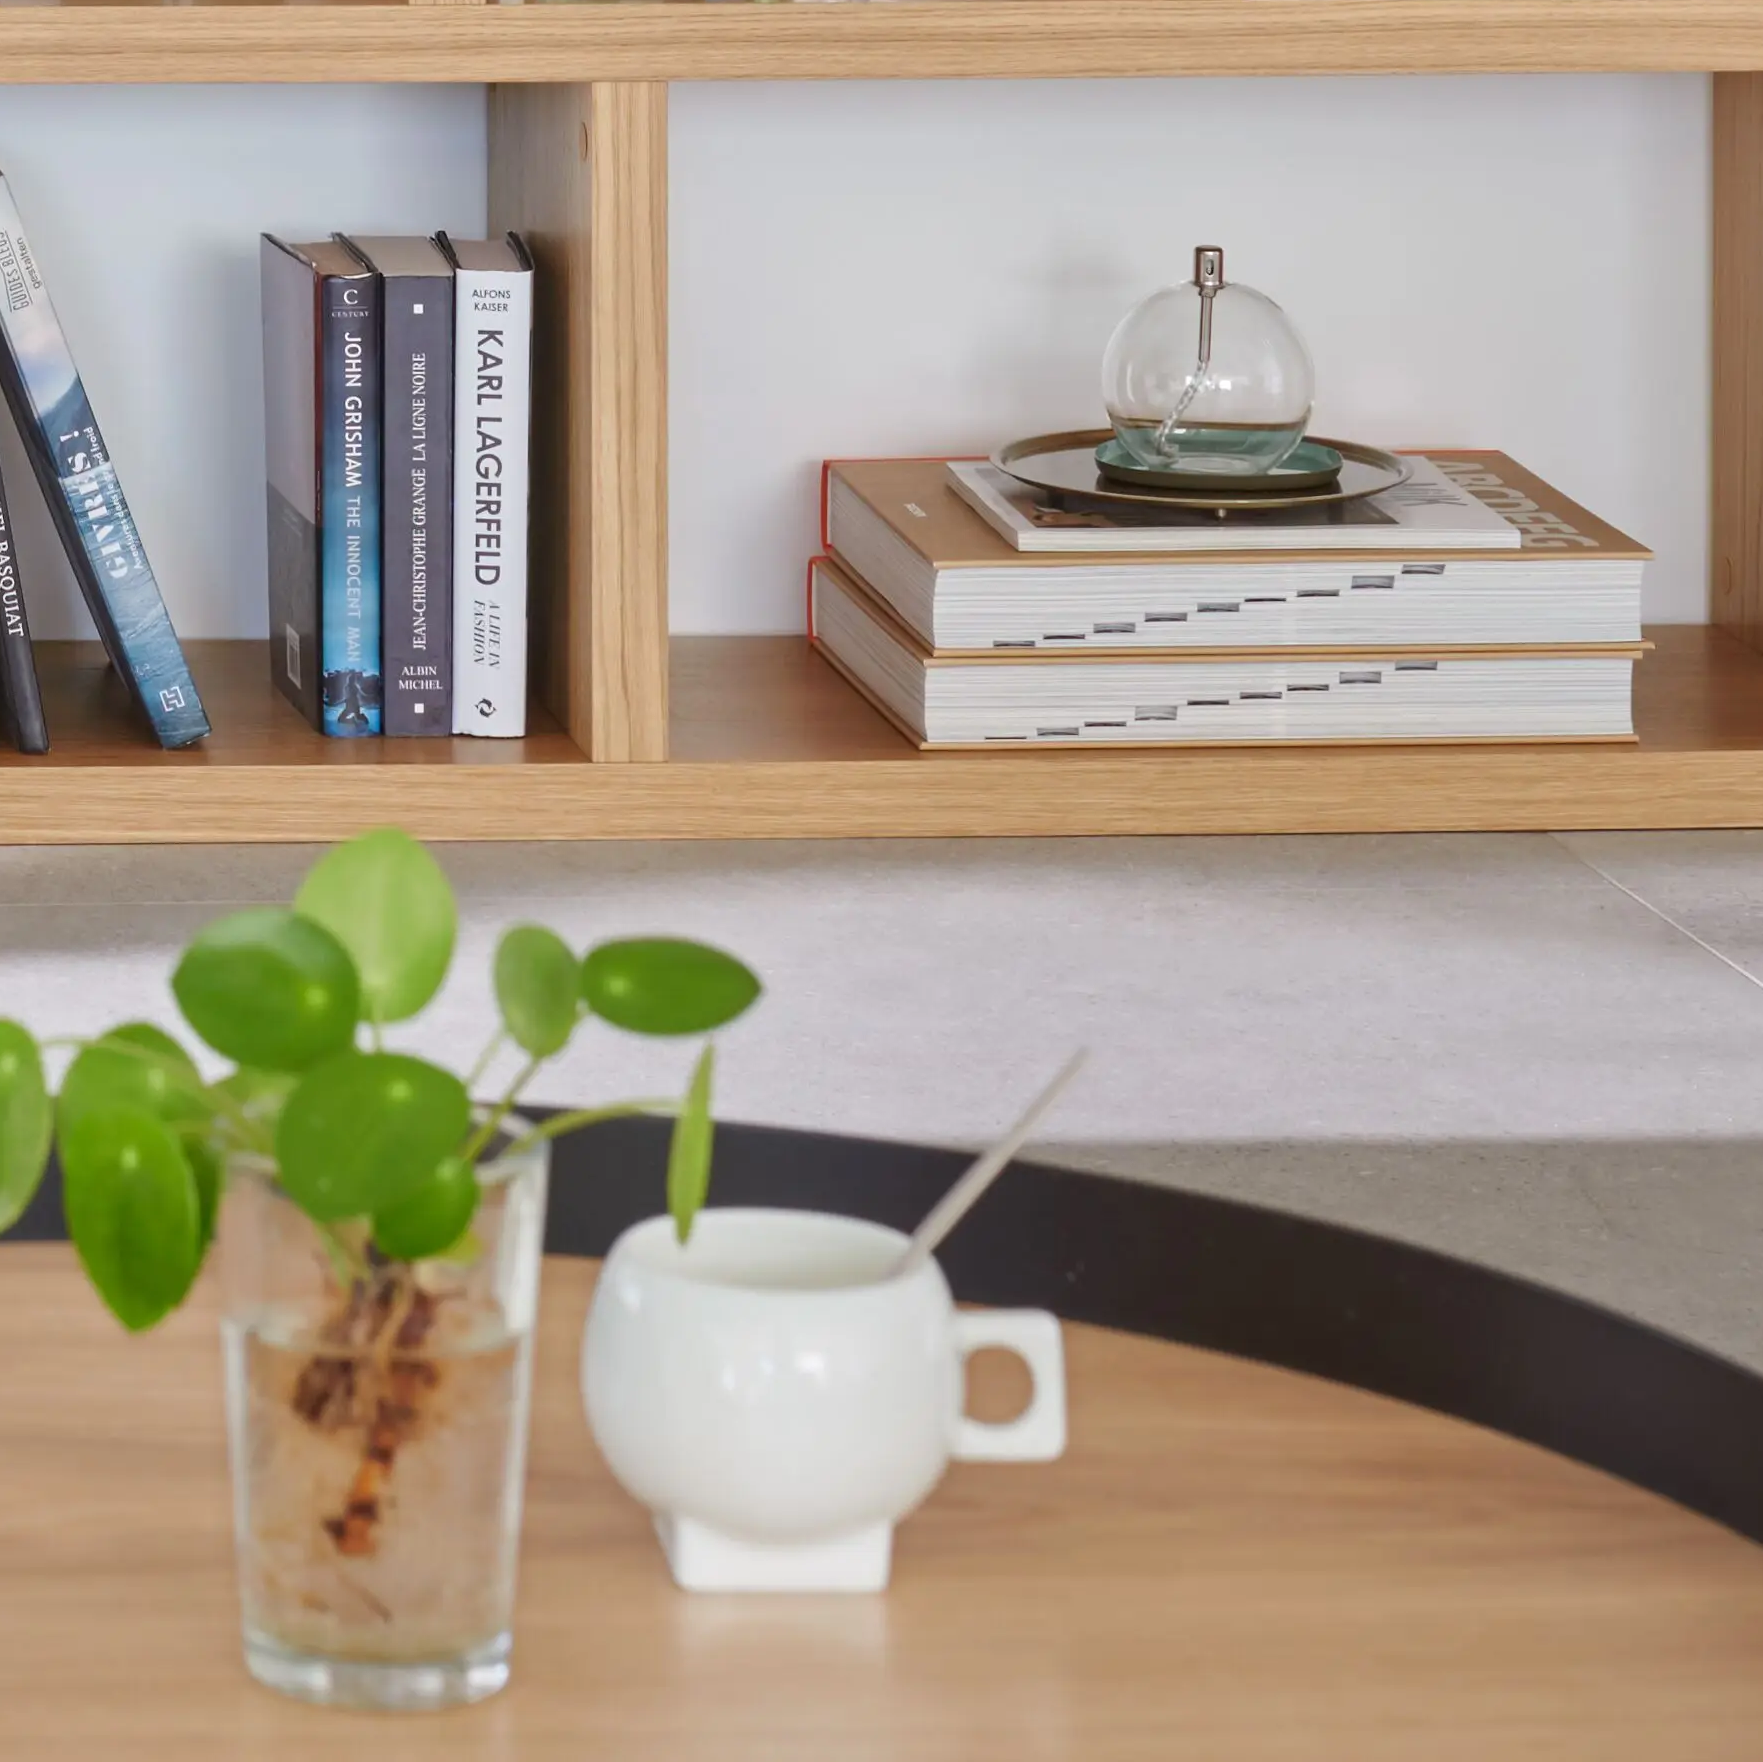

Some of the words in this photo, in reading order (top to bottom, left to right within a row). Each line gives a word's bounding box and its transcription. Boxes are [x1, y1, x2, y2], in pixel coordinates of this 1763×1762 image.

[16, 236, 43, 290] gestalten
[5, 268, 30, 311] GUIDES
[472, 289, 511, 300] ALFONS
[474, 302, 509, 313] KAISER
[344, 331, 363, 388] JOHN
[412, 352, 426, 395] NOIRE
[476, 329, 503, 406] KARL
[412, 398, 426, 440] LIGNE
[344, 395, 363, 487] GRISHAM
[412, 445, 426, 462] LA
[346, 495, 361, 528] THE
[474, 415, 503, 587] LAGERFELD
[346, 535, 361, 619] INNOCENT
[412, 528, 427, 650] JEAN-CHRISTOPHE
[347, 626, 361, 662] MAN
[473, 599, 486, 665] FASHION
[398, 679, 444, 690] MICHEL
[401, 666, 438, 676] ALBIN
